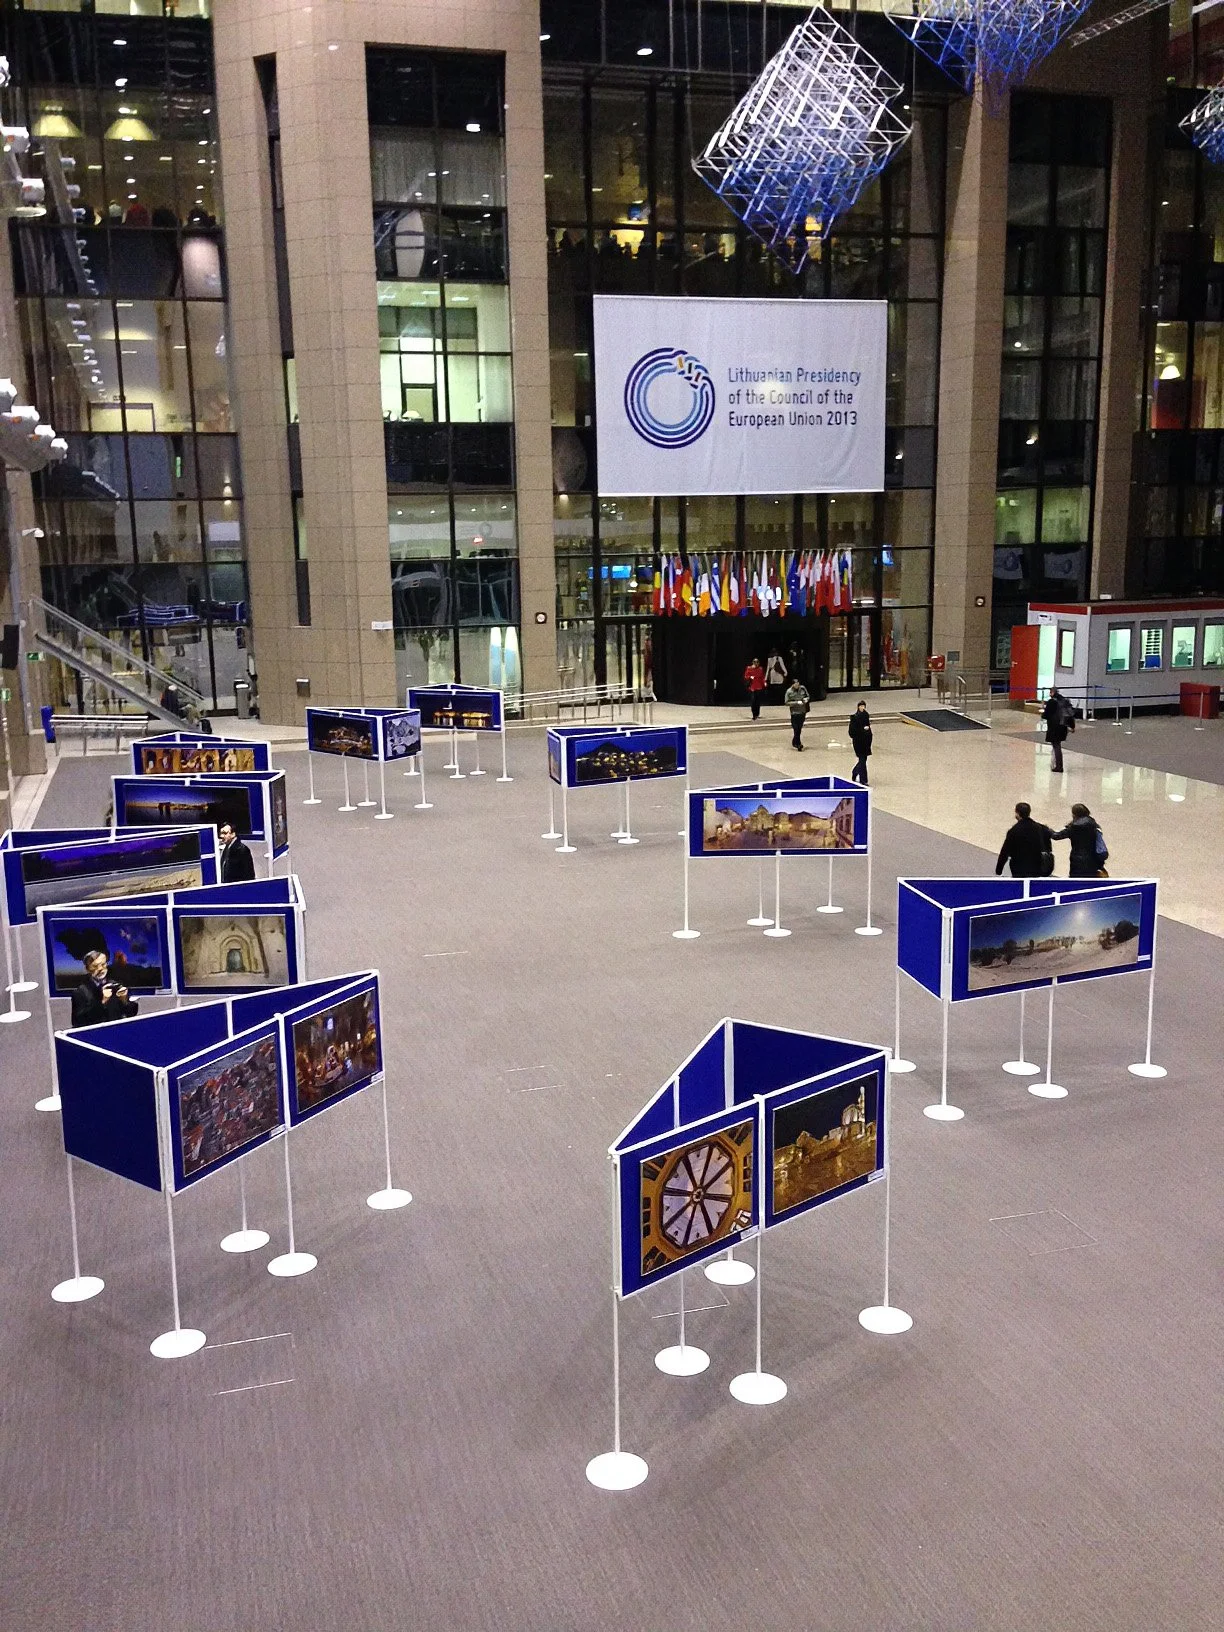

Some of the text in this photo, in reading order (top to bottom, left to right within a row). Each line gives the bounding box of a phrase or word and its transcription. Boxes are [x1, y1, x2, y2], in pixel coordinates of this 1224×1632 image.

[728, 367, 861, 387] Lithuanian Presidency
[728, 389, 853, 404] of the Council of the
[728, 410, 858, 429] European Union 2013
